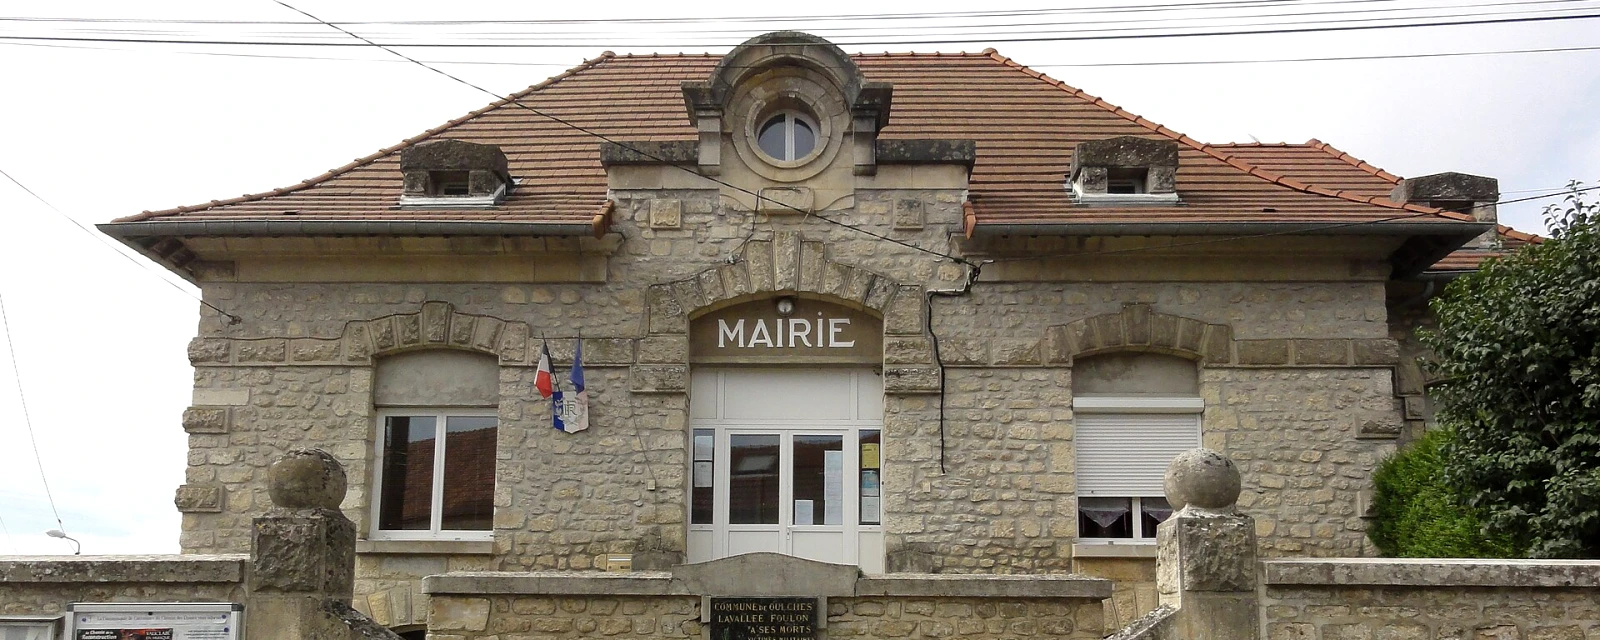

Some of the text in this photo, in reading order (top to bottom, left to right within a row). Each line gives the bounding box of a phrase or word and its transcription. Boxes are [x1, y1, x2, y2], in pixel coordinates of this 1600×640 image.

[717, 311, 855, 348] MAIRIE
[714, 602, 758, 611] COMMUNE
[769, 602, 813, 611] OULCHES
[770, 614, 809, 622] FOULON
[758, 626, 776, 634] SES
[779, 626, 811, 634] MORTS
